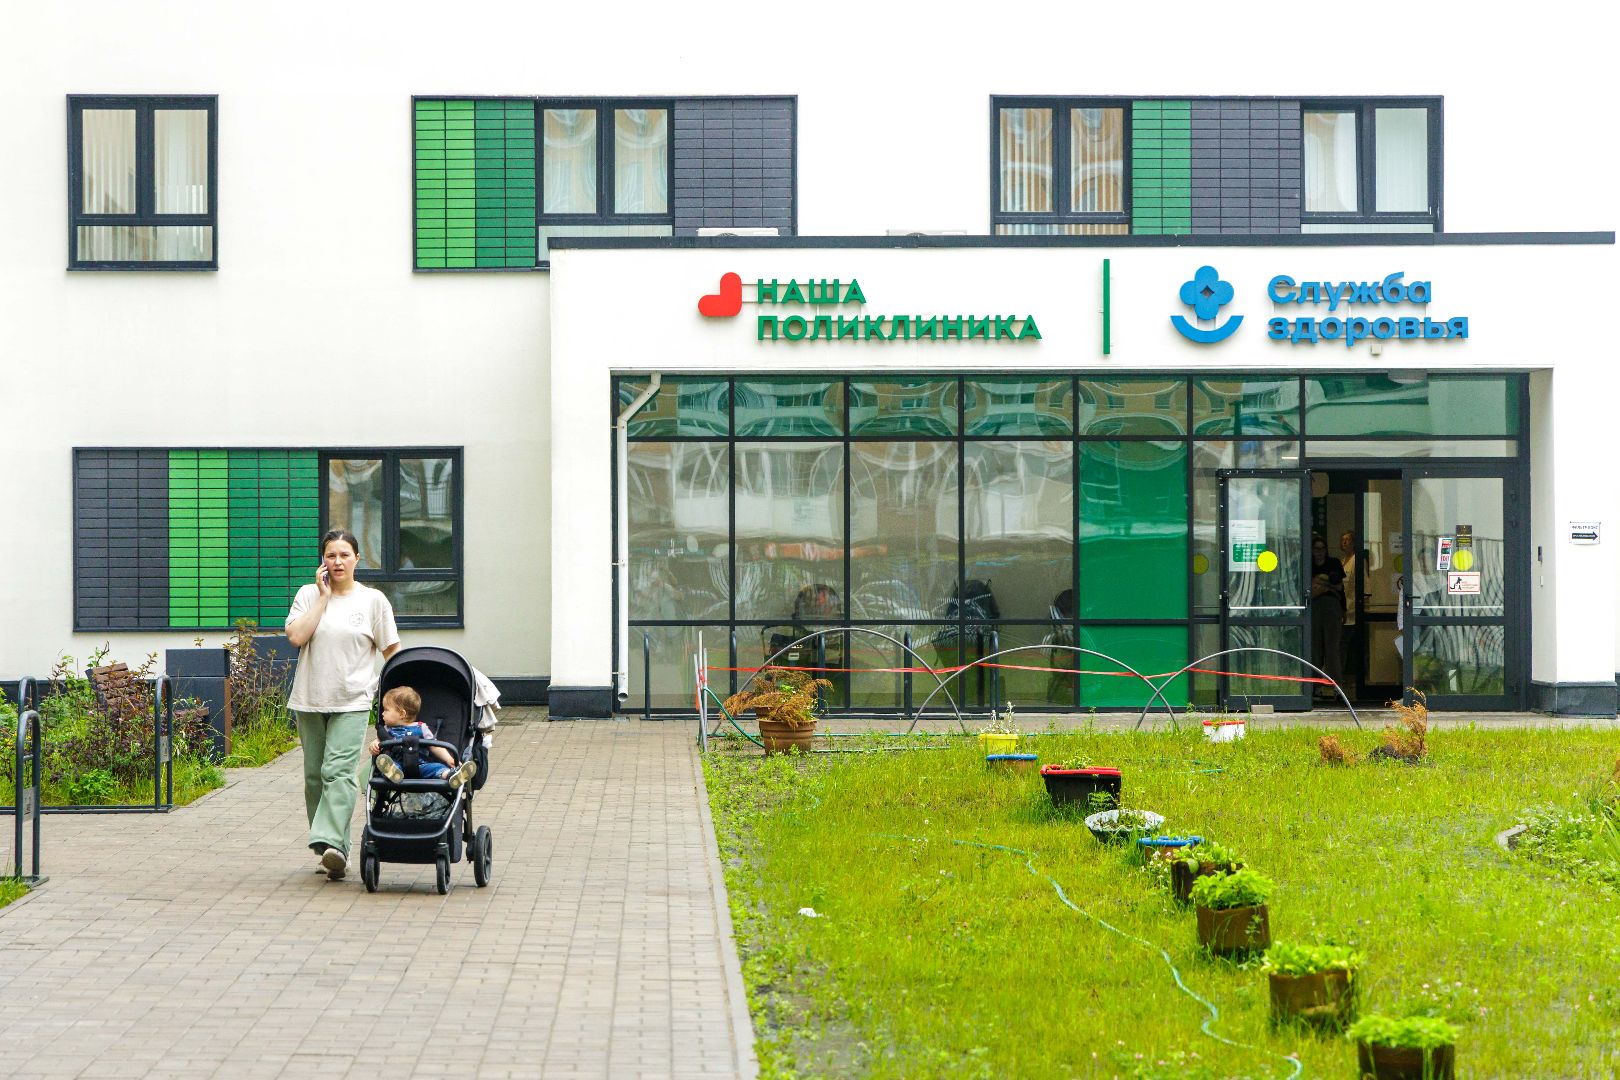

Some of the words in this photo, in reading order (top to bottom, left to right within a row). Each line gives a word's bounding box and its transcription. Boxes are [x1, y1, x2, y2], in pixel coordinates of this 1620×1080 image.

[757, 278, 867, 304] НАША
[1267, 271, 1432, 311] Служба
[757, 314, 1042, 341] ПОЛИКЛИНИКА
[1267, 316, 1469, 346] здоровья
